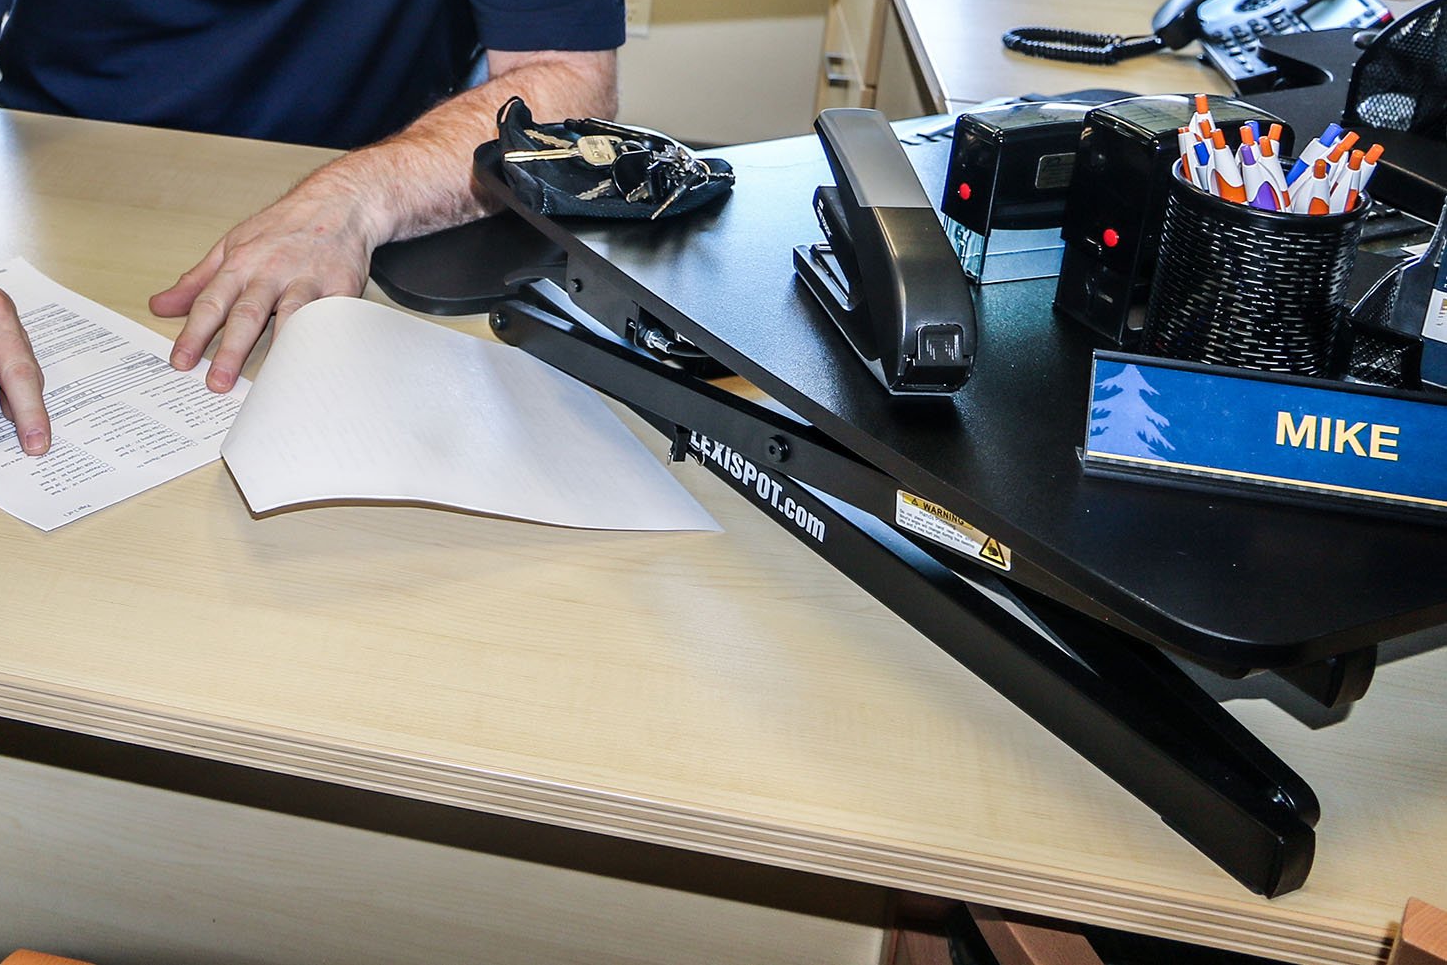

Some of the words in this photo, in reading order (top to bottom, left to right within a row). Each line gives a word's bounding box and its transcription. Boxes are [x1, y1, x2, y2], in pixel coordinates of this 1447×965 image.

[1275, 411, 1401, 462] MIKE
[689, 430, 826, 543] LEXISPOT.com
[923, 503, 965, 526] WARNING
